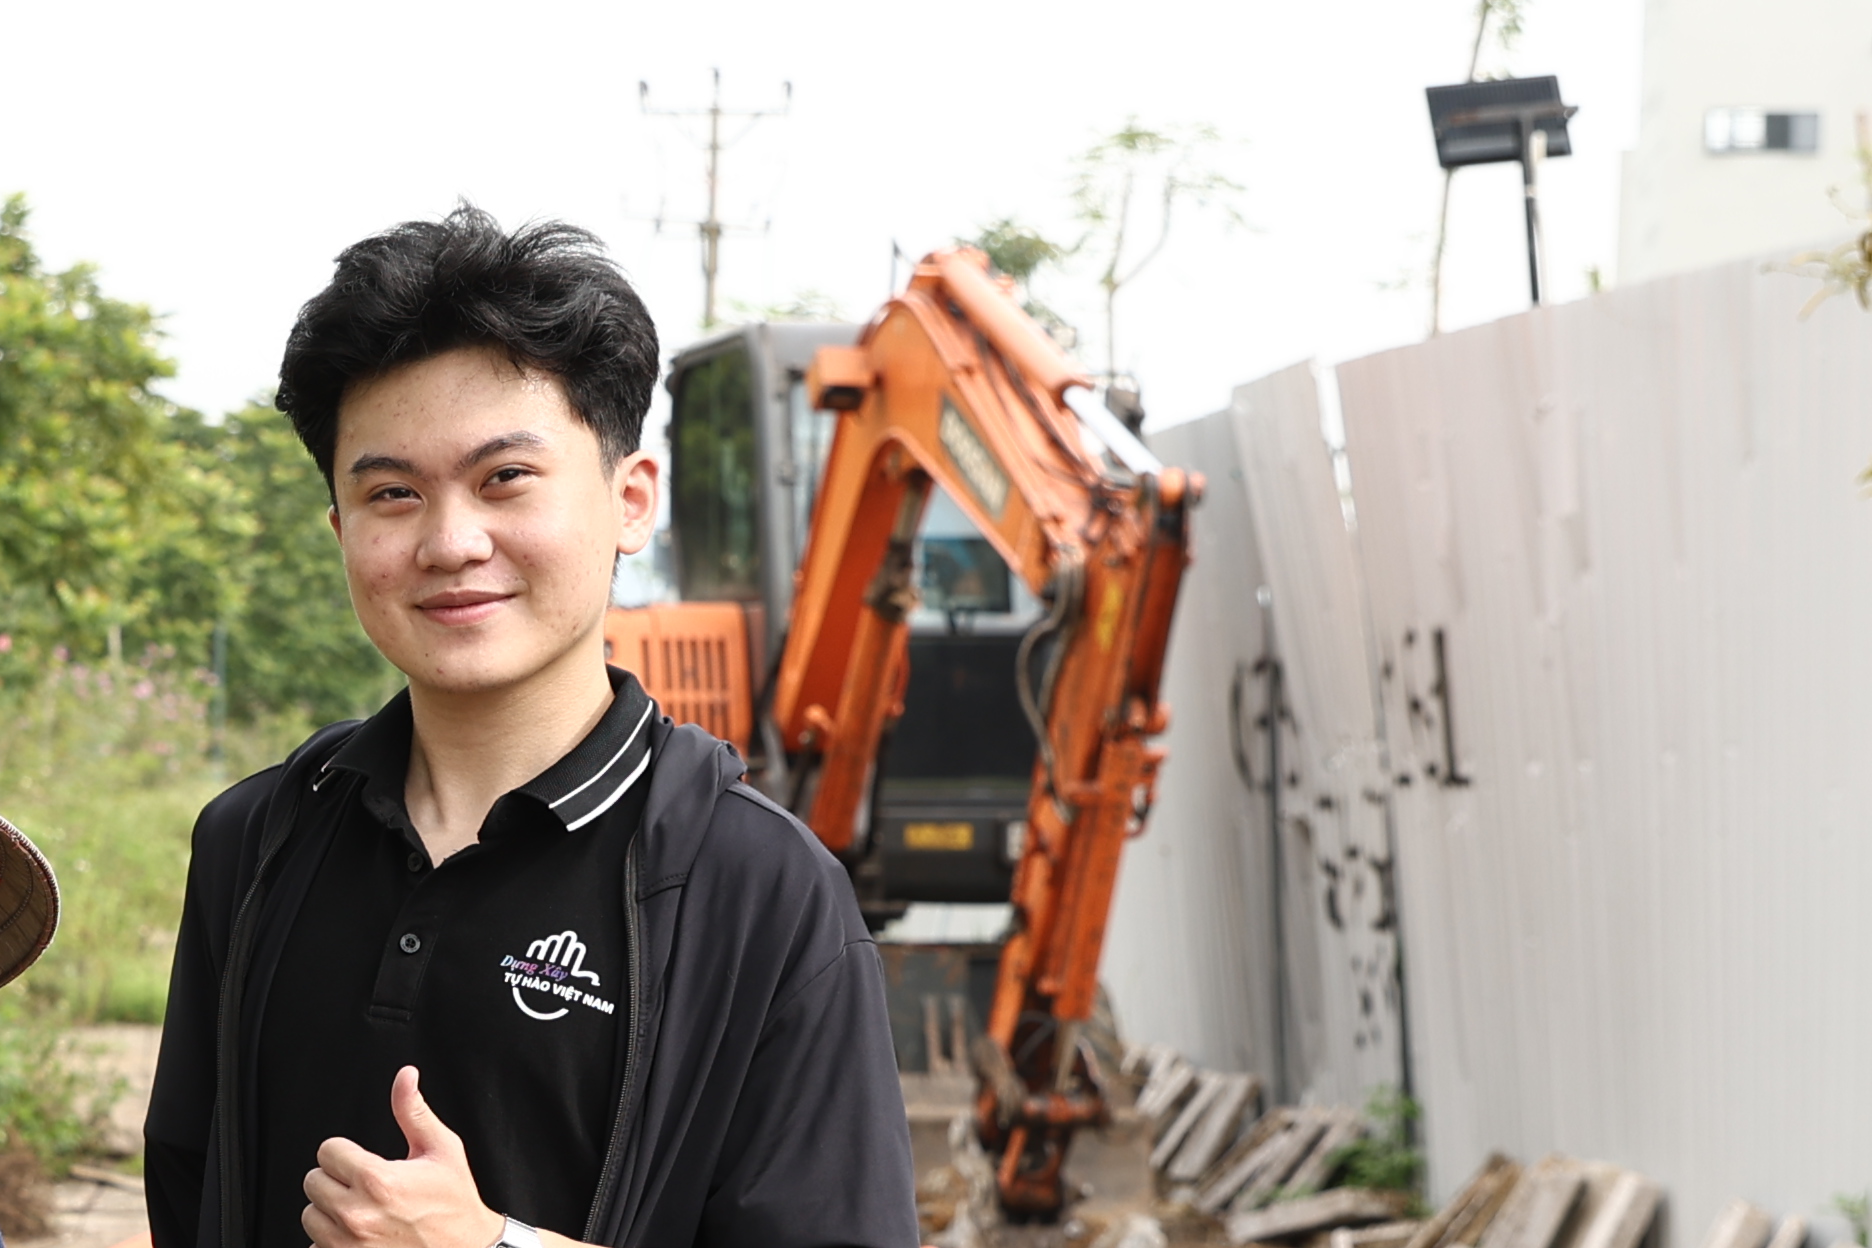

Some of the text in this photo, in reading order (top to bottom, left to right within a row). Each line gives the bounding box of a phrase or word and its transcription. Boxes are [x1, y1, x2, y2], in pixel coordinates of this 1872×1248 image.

[500, 954, 568, 982] Dựng Xây
[521, 976, 551, 992] HÀO
[552, 983, 583, 1001] VIỆT
[582, 993, 615, 1015] NAM
